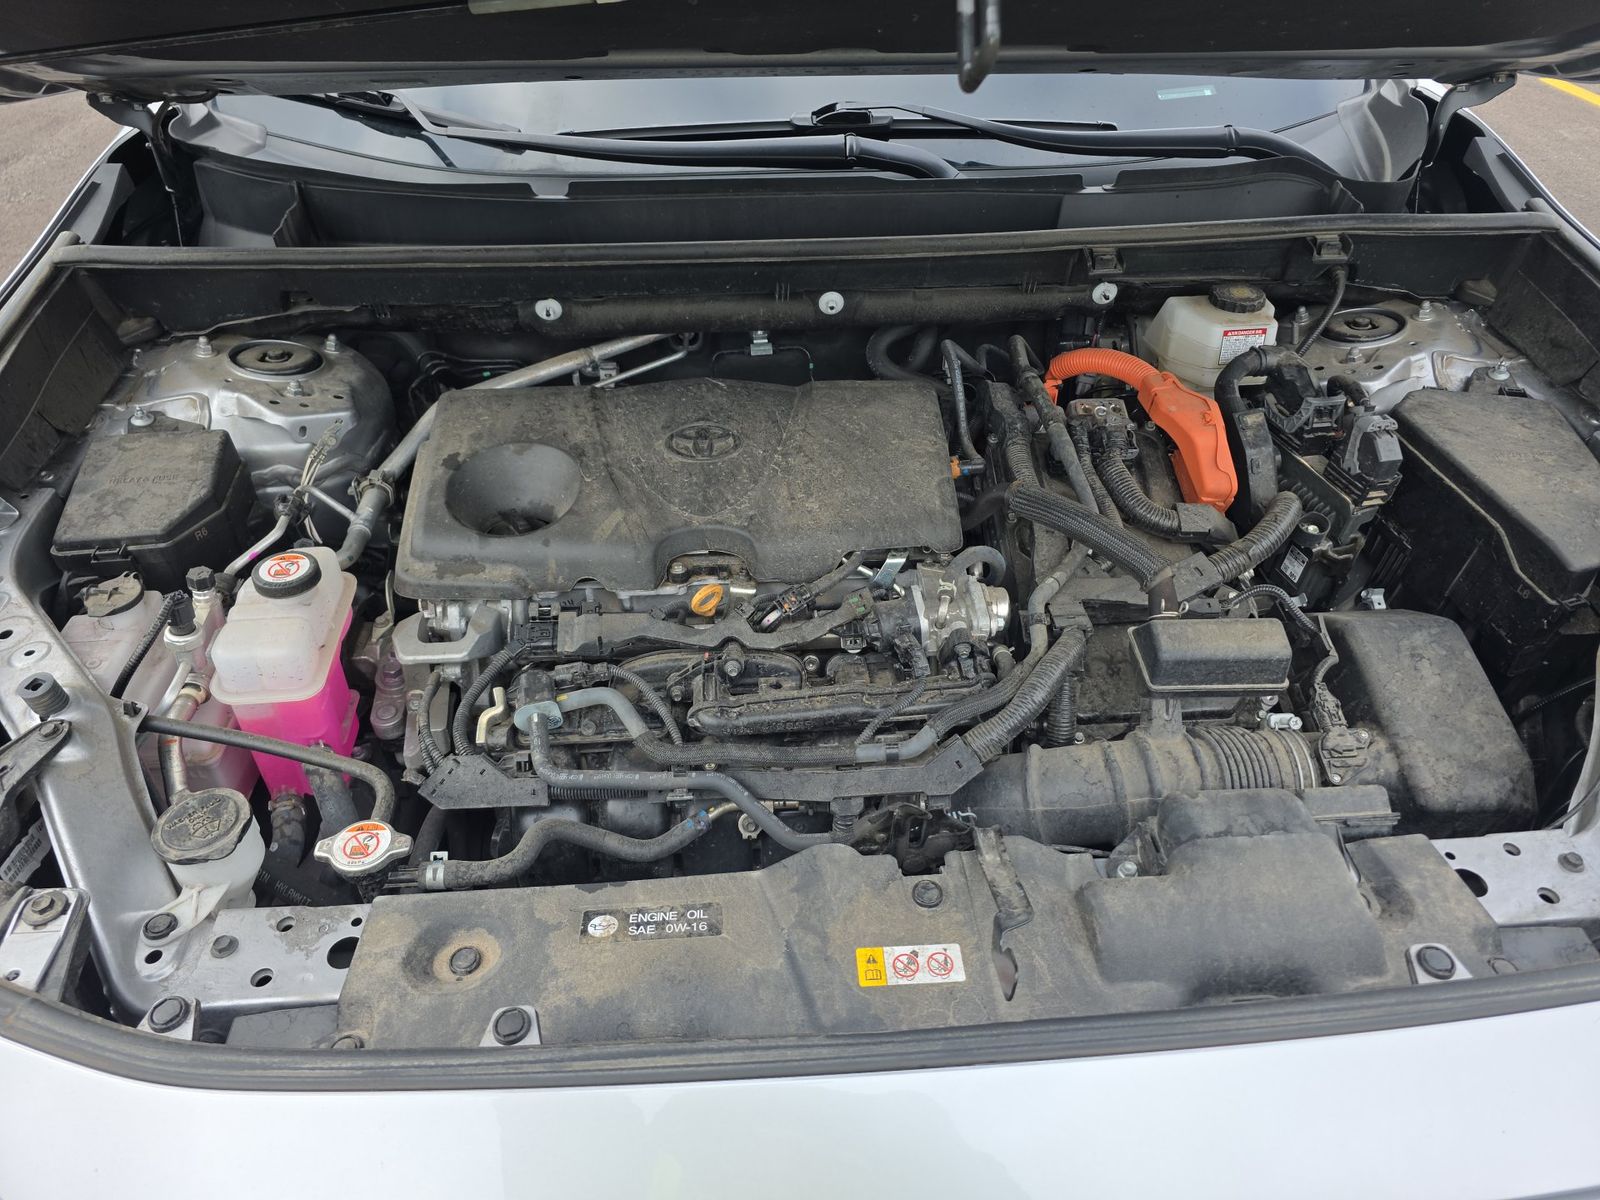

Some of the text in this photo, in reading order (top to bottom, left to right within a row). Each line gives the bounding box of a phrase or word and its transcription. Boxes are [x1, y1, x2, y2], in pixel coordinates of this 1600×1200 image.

[194, 527, 208, 541] R6
[629, 909, 708, 923] ENGINE OIL
[628, 921, 708, 936] SAE 0W-16
